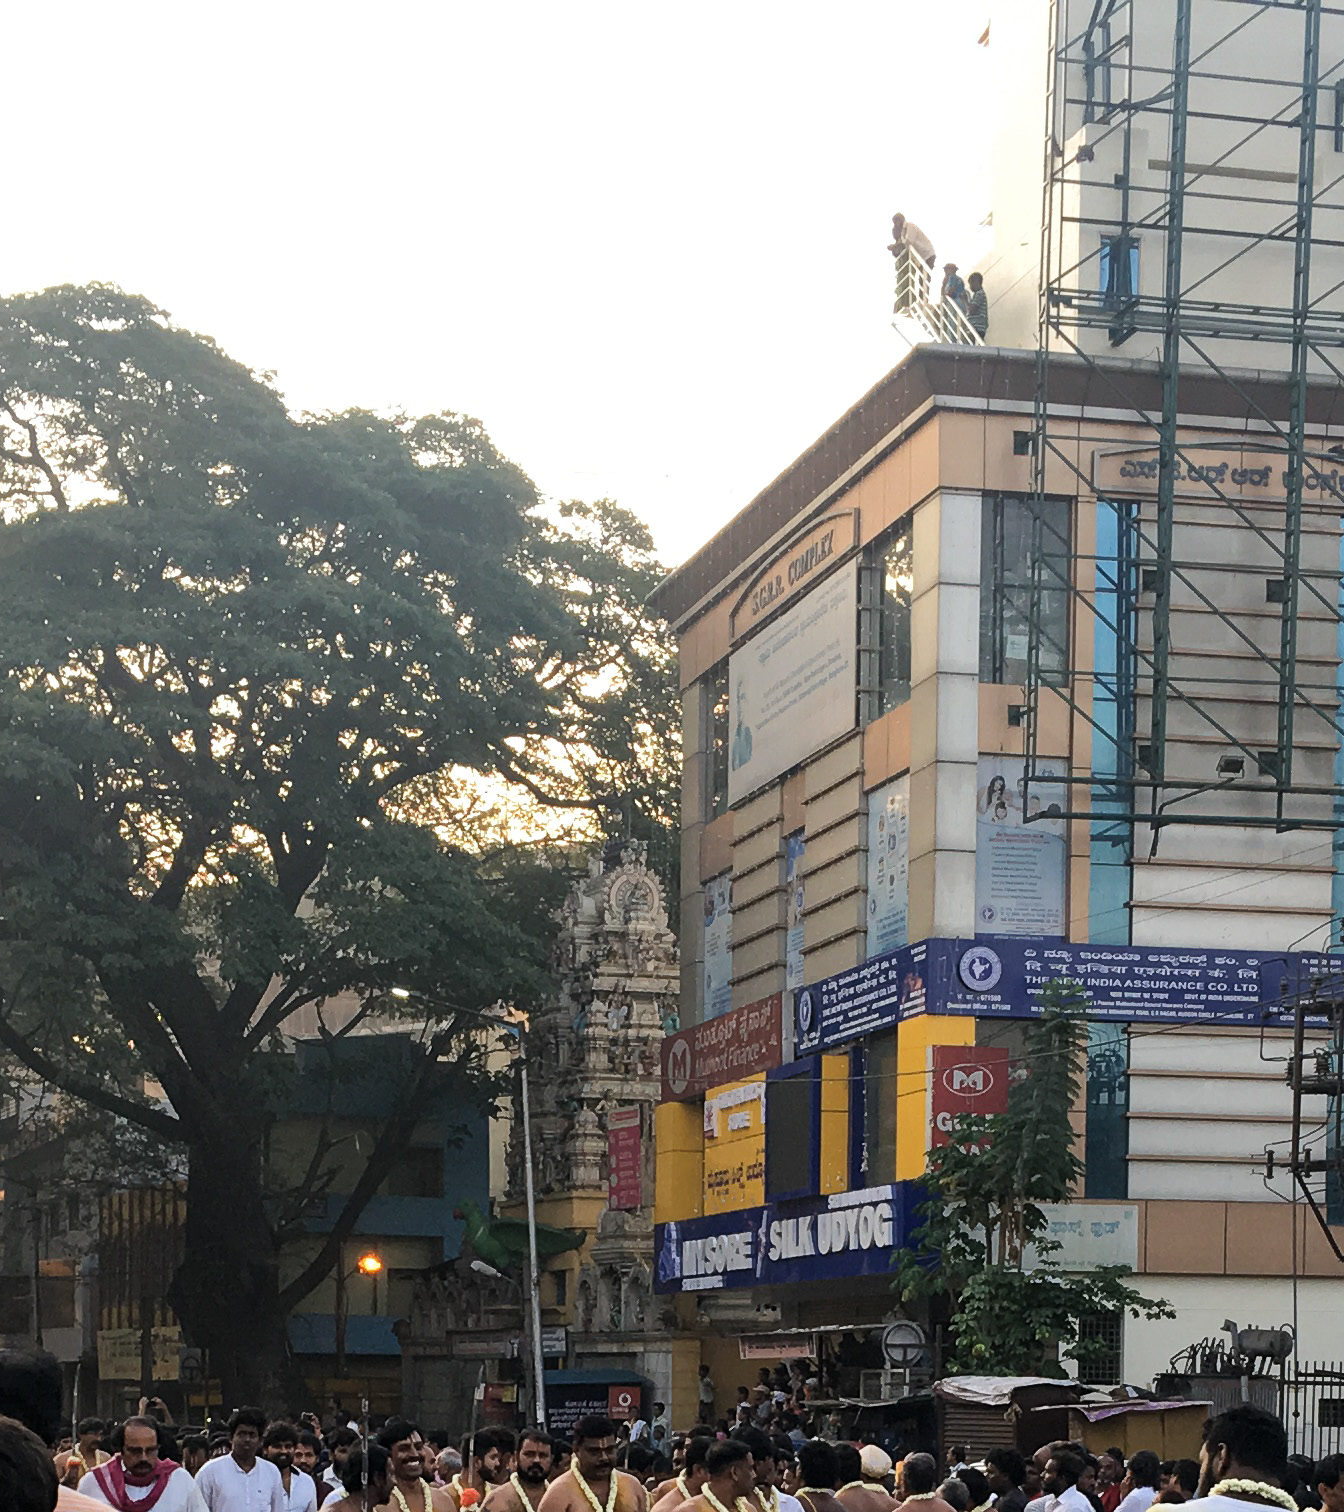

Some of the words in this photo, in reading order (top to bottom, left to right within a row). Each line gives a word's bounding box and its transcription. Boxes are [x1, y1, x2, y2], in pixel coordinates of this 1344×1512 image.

[787, 529, 834, 587] COMPLEX
[1024, 975, 1050, 985] THE
[1054, 976, 1085, 986] NEW
[1087, 977, 1122, 988] INDIA
[1124, 979, 1205, 991] ASSURANCE
[1207, 982, 1232, 992] CO.
[728, 1041, 760, 1069] Finance
[682, 1231, 753, 1277] MYSORE
[768, 1215, 816, 1262] SILK
[817, 1202, 893, 1256] UDYOG
